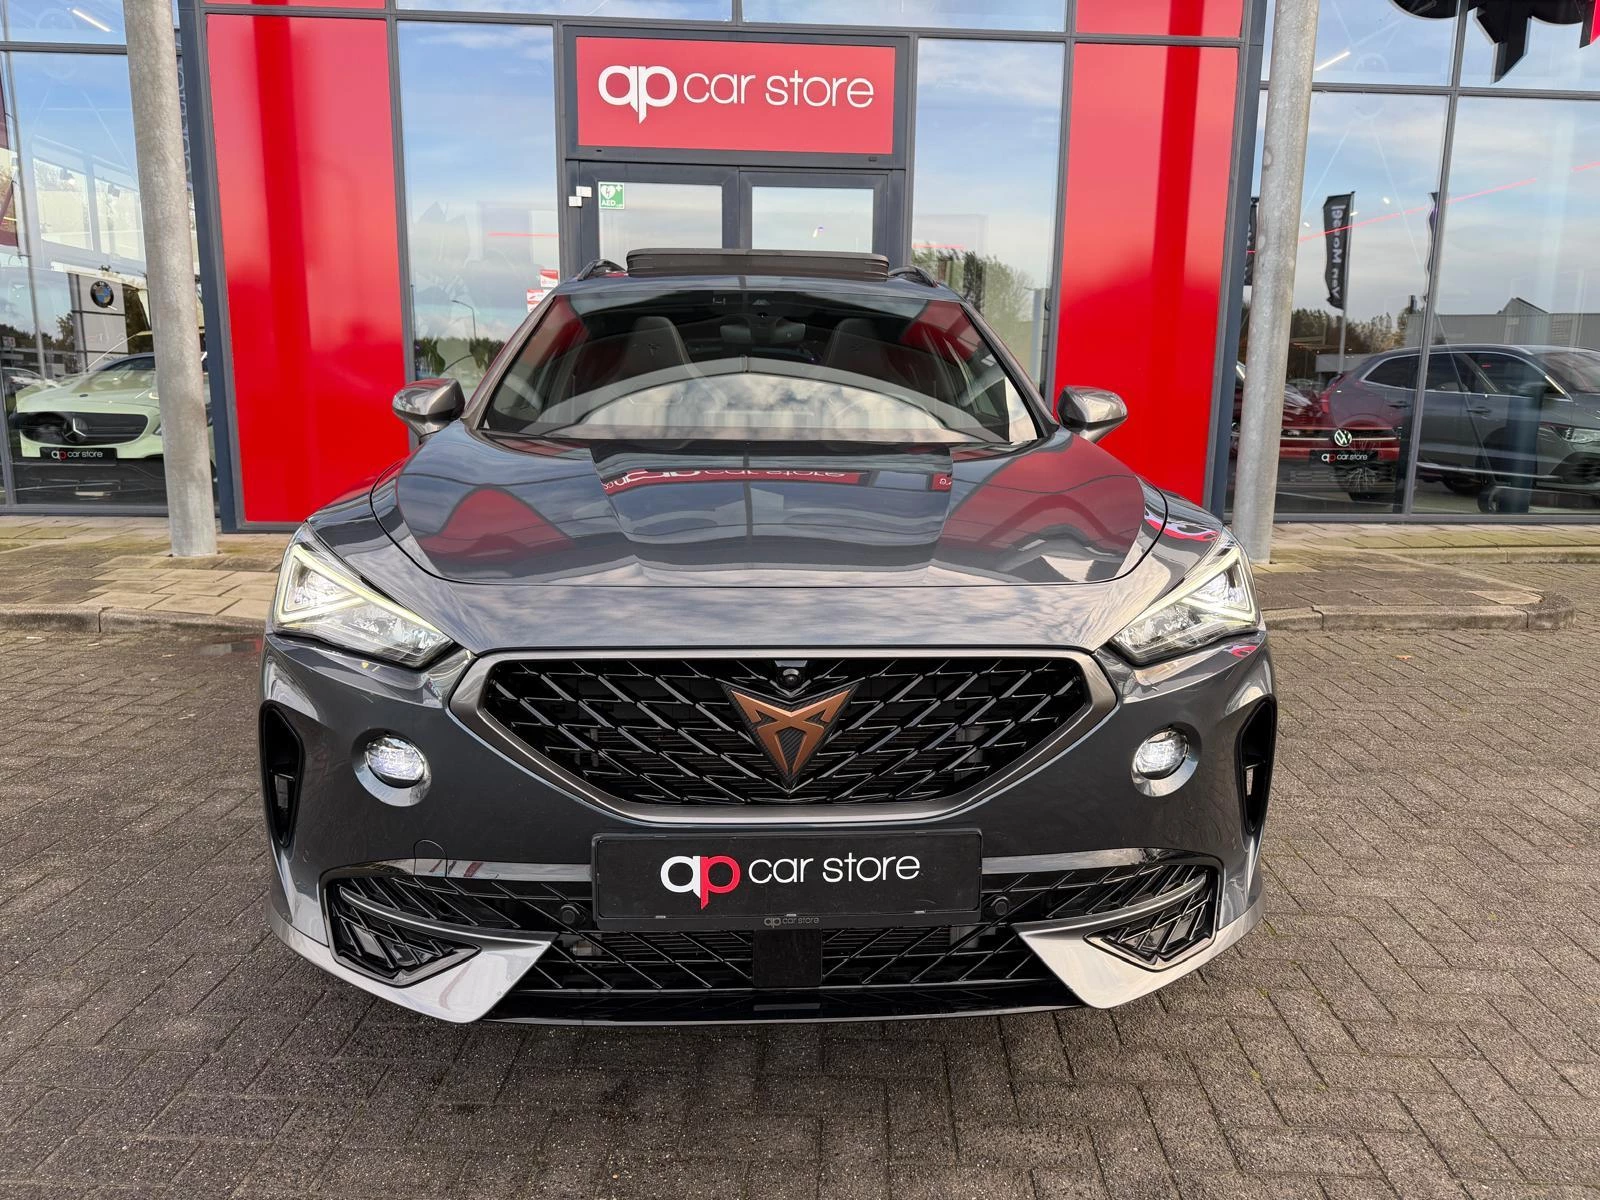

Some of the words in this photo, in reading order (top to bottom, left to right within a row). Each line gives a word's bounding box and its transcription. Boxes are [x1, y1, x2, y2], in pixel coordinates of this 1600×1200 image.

[597, 65, 678, 124] ap
[683, 72, 757, 105] car
[766, 69, 875, 108] store
[601, 199, 616, 207] AED
[82, 450, 104, 458] store
[1349, 453, 1368, 461] store
[660, 855, 741, 910] ap
[748, 857, 815, 884] car
[822, 852, 920, 883] store
[763, 917, 782, 928] ap
